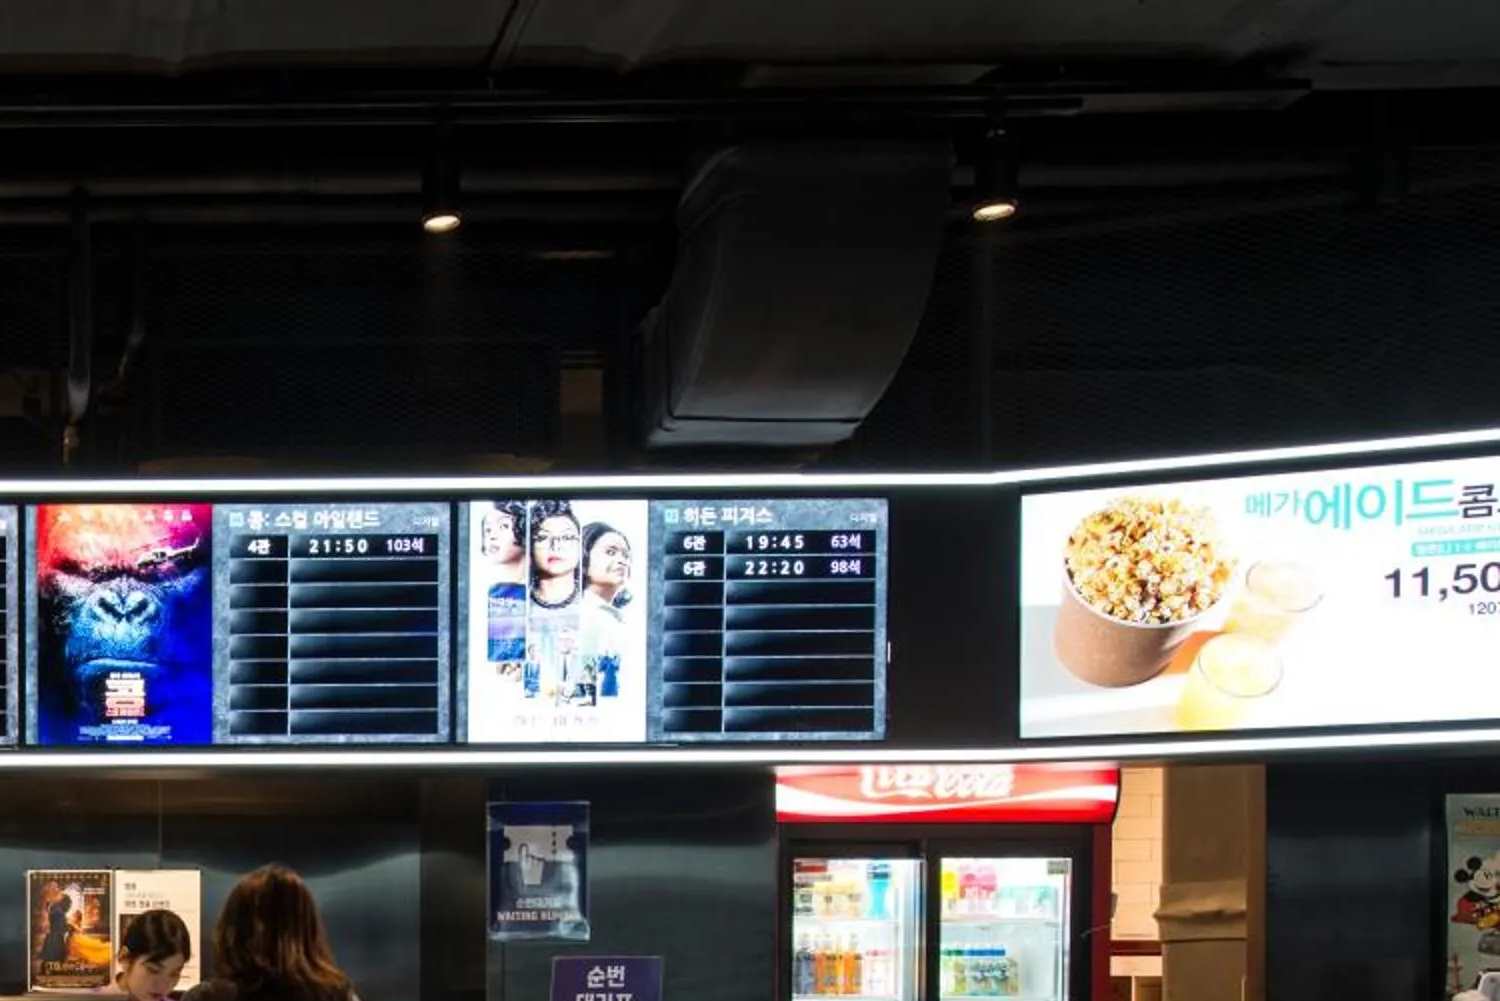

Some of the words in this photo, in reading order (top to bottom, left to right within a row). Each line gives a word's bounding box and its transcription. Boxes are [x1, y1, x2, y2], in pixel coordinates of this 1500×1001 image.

[1245, 478, 1500, 530] 메가에이드콤
[309, 539, 368, 553] 21:50
[746, 535, 804, 548] 19:45
[745, 561, 804, 575] 22:20
[1469, 600, 1500, 615] 120
[587, 965, 626, 988] 순번
